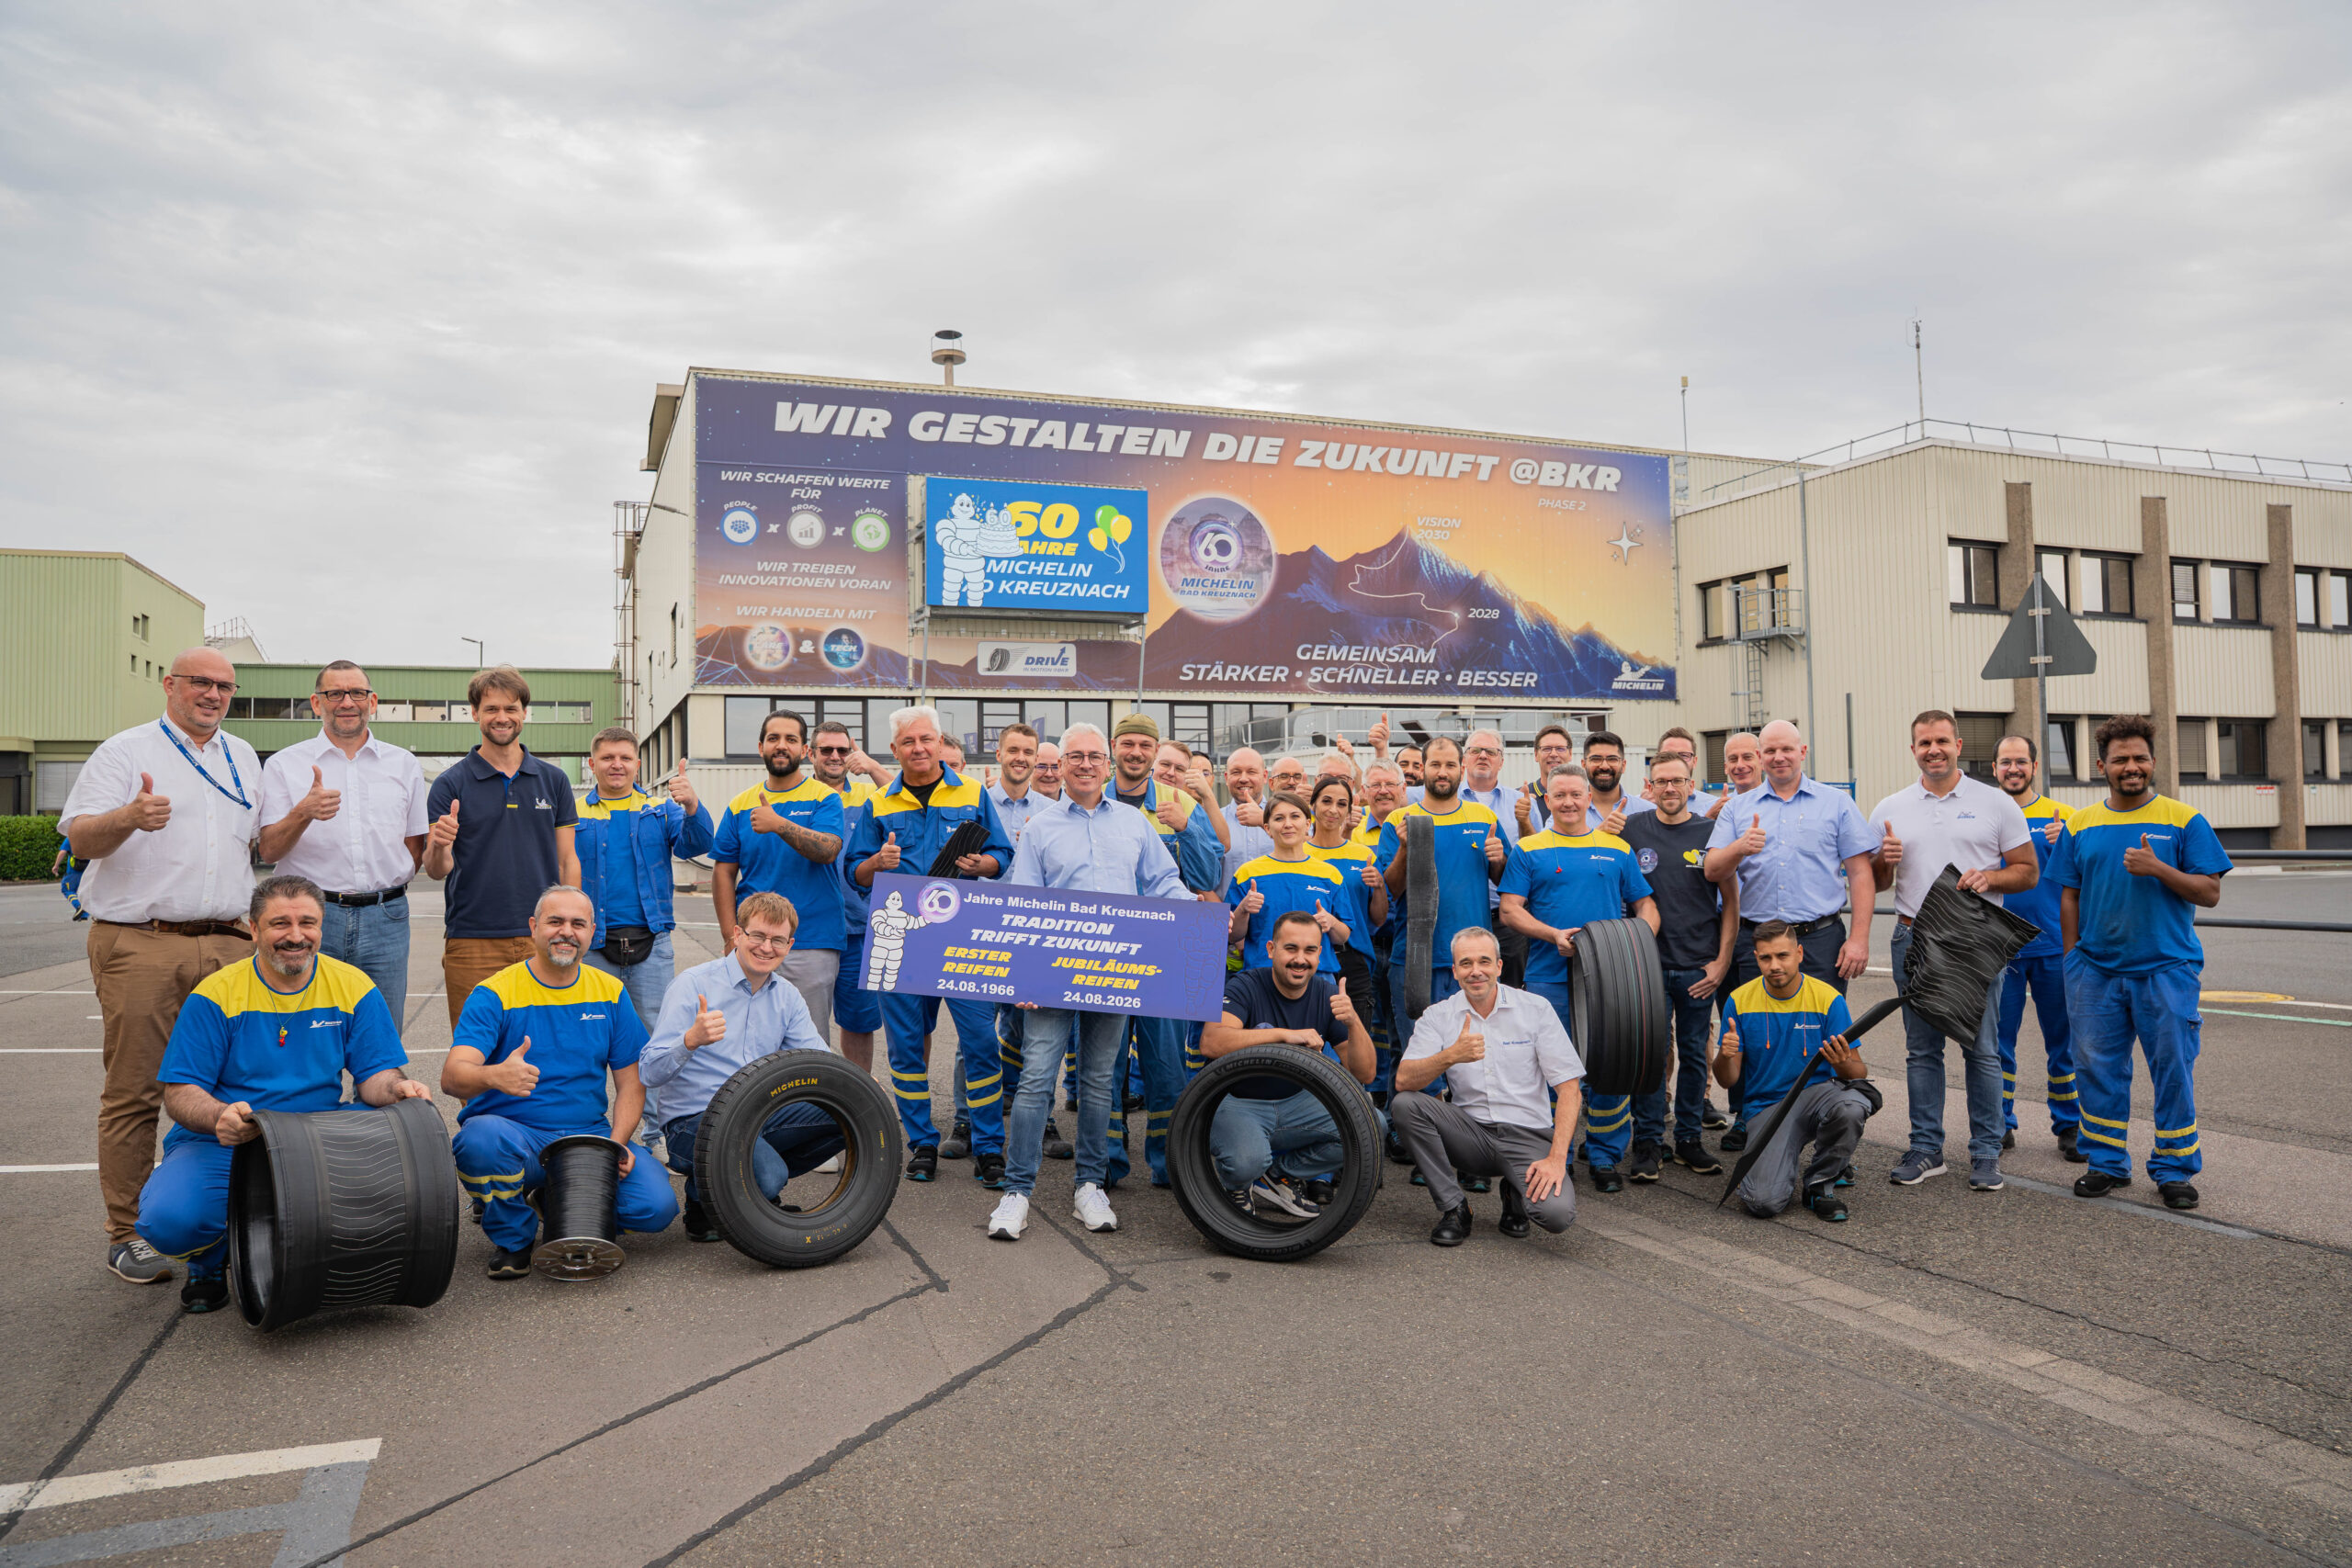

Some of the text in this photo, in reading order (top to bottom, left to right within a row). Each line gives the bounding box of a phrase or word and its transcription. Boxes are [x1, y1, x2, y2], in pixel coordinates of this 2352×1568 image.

[775, 401, 1622, 492] WIR GESTALTEN DIE ZUKUNFT @BKR
[720, 470, 891, 490] WIR SCHAFFEN WERTE
[791, 487, 822, 499] FÜR
[724, 501, 758, 512] PEOPLE
[791, 504, 822, 513] PROFIT
[854, 507, 888, 517] PLANET
[1538, 497, 1586, 511] PHASE 2
[1007, 501, 1080, 539] 60
[1416, 516, 1461, 529] VISION
[1416, 528, 1450, 541] 2030
[1020, 540, 1079, 556] AHRE
[1198, 533, 1237, 563] 60
[756, 561, 856, 574] WIR TREIBEN
[986, 559, 1093, 577] MICHELIN
[1204, 565, 1230, 573] JAHRE
[718, 574, 891, 590] INNOVATIONEN VORAN
[998, 581, 1130, 599] KREUZNACH
[1181, 578, 1254, 590] MICHELIN
[736, 605, 876, 620] WIR HANDELN MIT
[1467, 607, 1499, 619] 2028
[1024, 651, 1069, 667] DRIVE
[1296, 644, 1436, 664] GEMEINSAM
[1180, 662, 1538, 688] STÄRKER SCHNELLER BESSER
[1611, 682, 1664, 690] MICHELIN
[922, 889, 1175, 921] 60 Jahre Michelin Bad Kreuznach
[1001, 914, 1114, 935] TRADITION
[970, 929, 1142, 955] TRIFFT ZUKUNFT
[944, 946, 1012, 962] ERSTER
[942, 961, 1010, 977] REIFEN
[1051, 956, 1162, 976] JUBILÄUMS-
[936, 978, 1015, 997] 24.08.1966
[1072, 974, 1139, 990] REIFEN
[1063, 990, 1141, 1009] 24.08.2026
[1227, 1059, 1272, 1070] MICHELIN
[771, 1077, 819, 1098] MICHELIN
